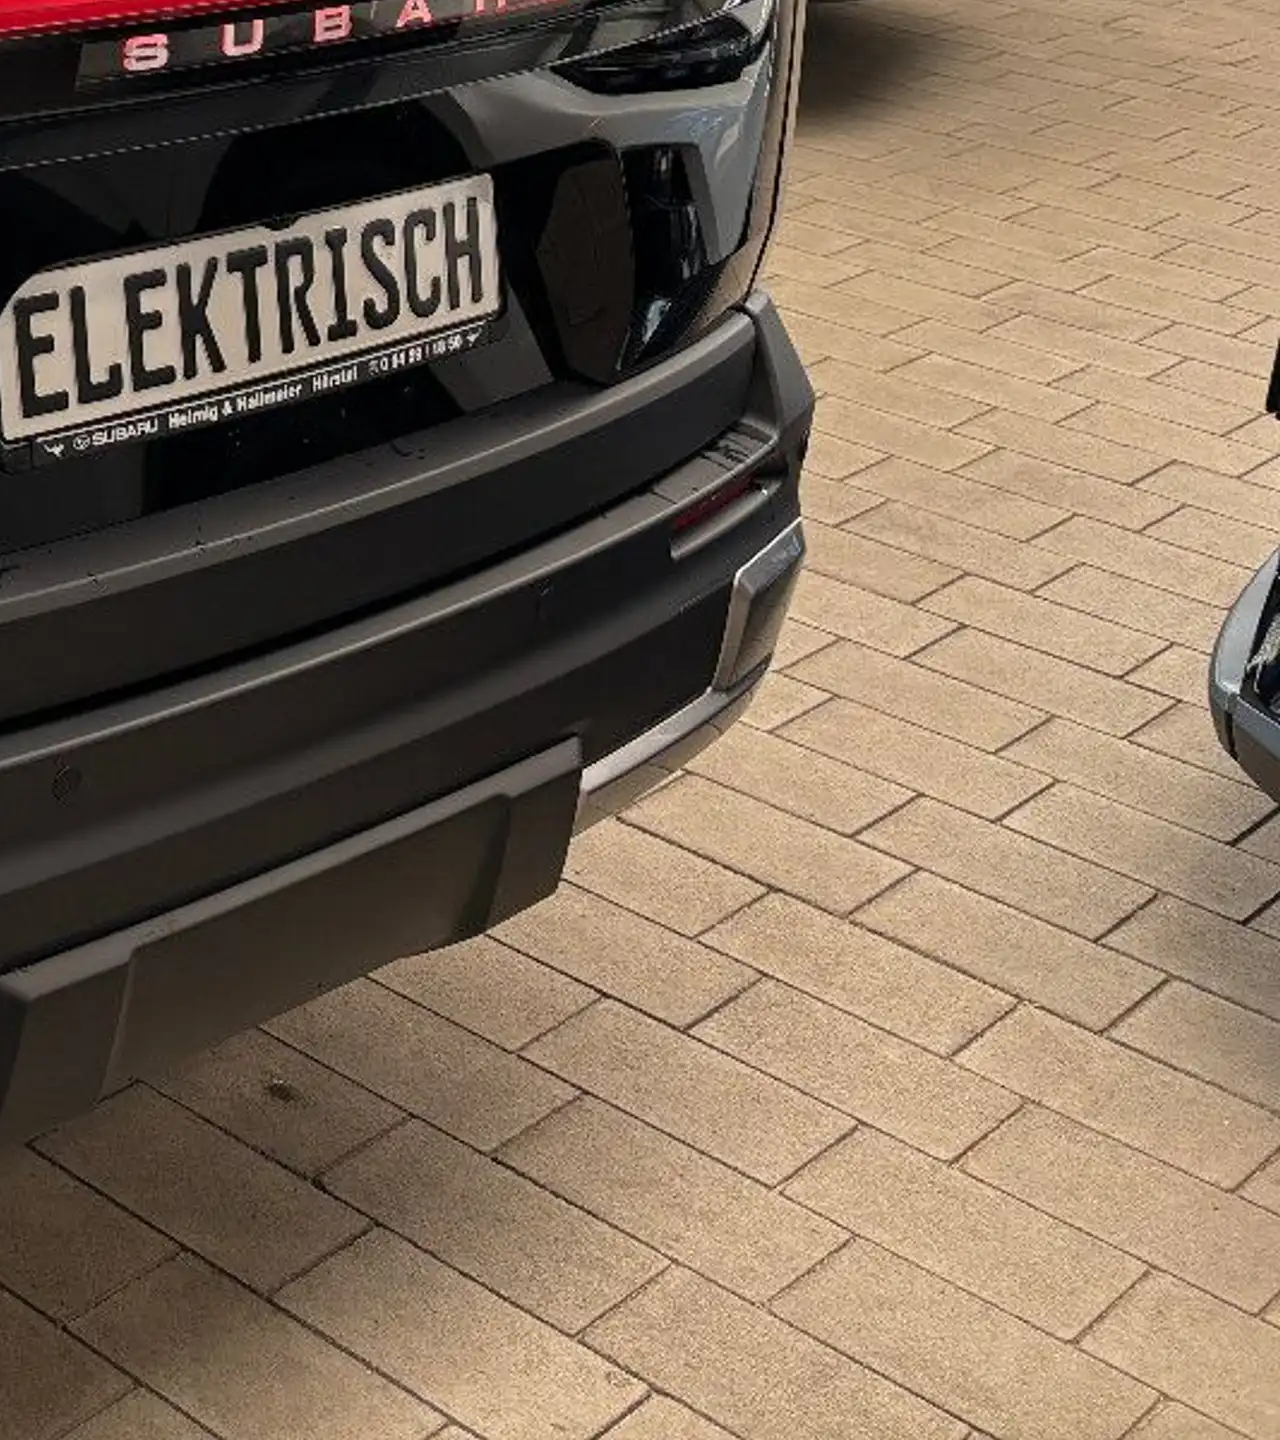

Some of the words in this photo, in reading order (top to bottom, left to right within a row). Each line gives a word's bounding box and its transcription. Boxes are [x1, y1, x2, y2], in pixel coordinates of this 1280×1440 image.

[12, 196, 484, 420] ELEKTRISCH
[91, 417, 159, 446] SUBARU
[167, 404, 219, 429] Helmig
[221, 400, 233, 417] &
